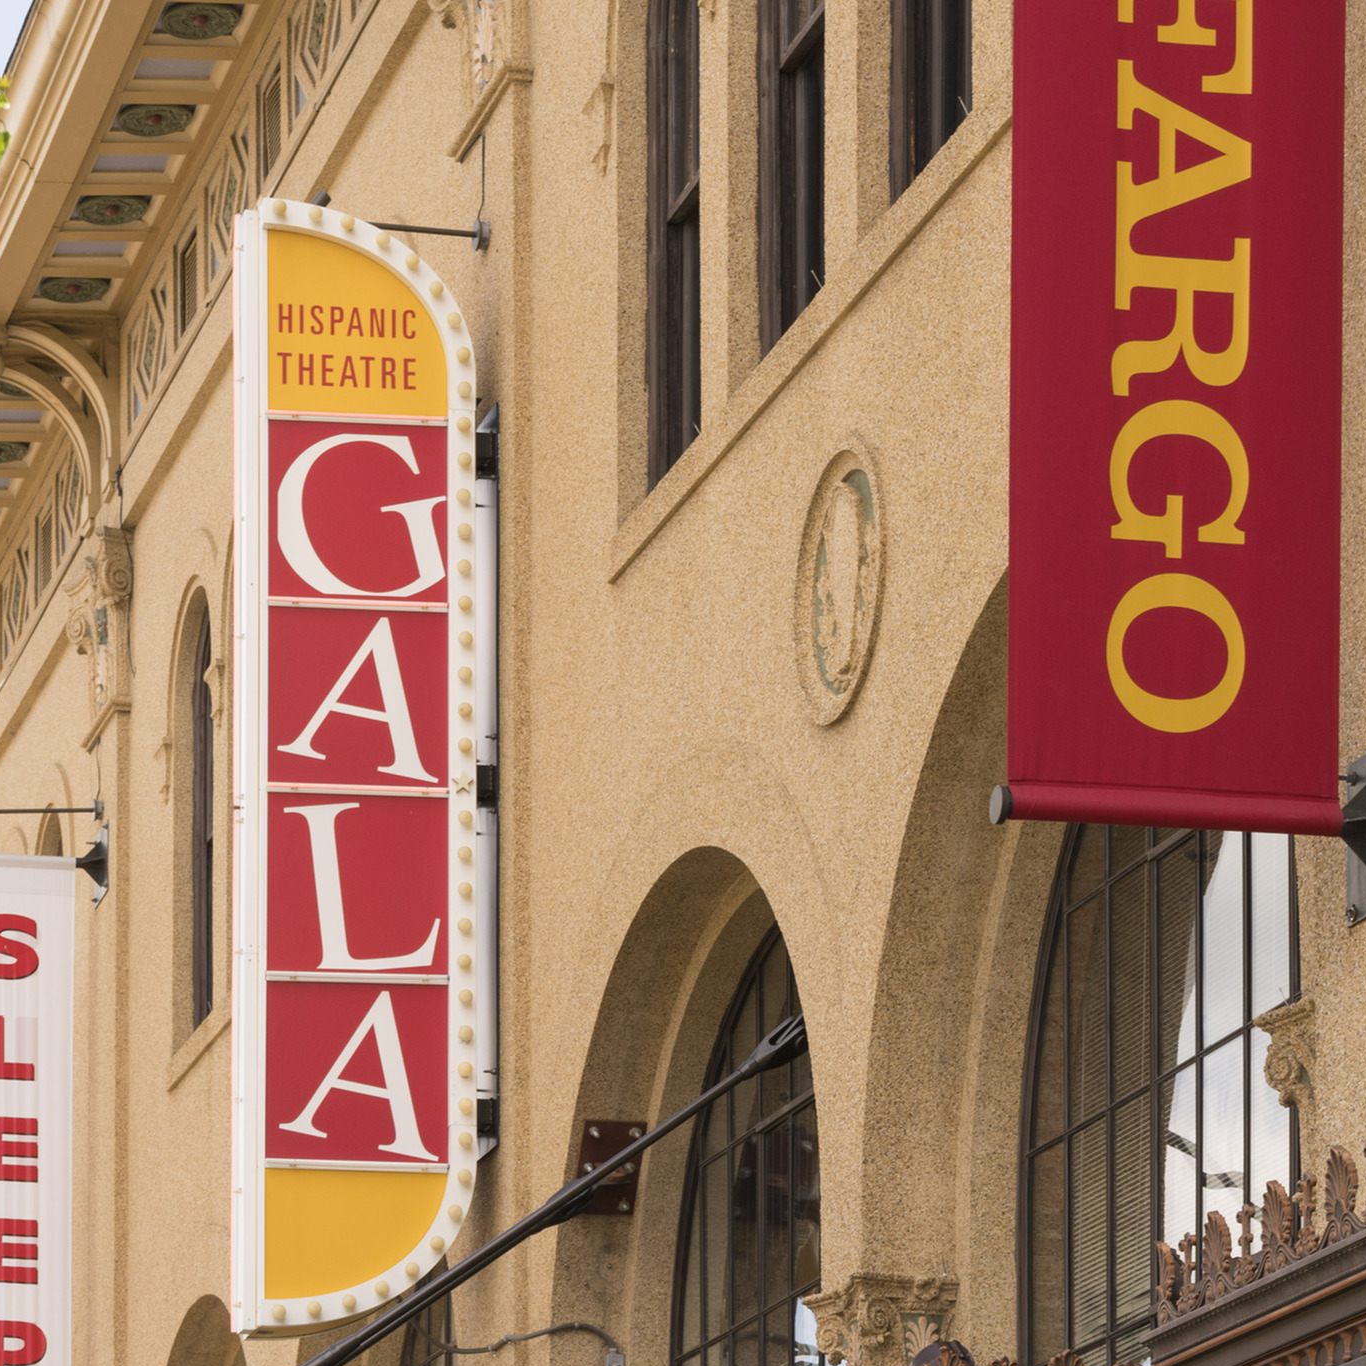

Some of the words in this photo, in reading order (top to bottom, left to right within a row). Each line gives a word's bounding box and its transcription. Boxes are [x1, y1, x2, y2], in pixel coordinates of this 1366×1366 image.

[277, 303, 417, 340] HISPANIC
[277, 352, 417, 391] THEATRE
[277, 433, 447, 1161] GALA
